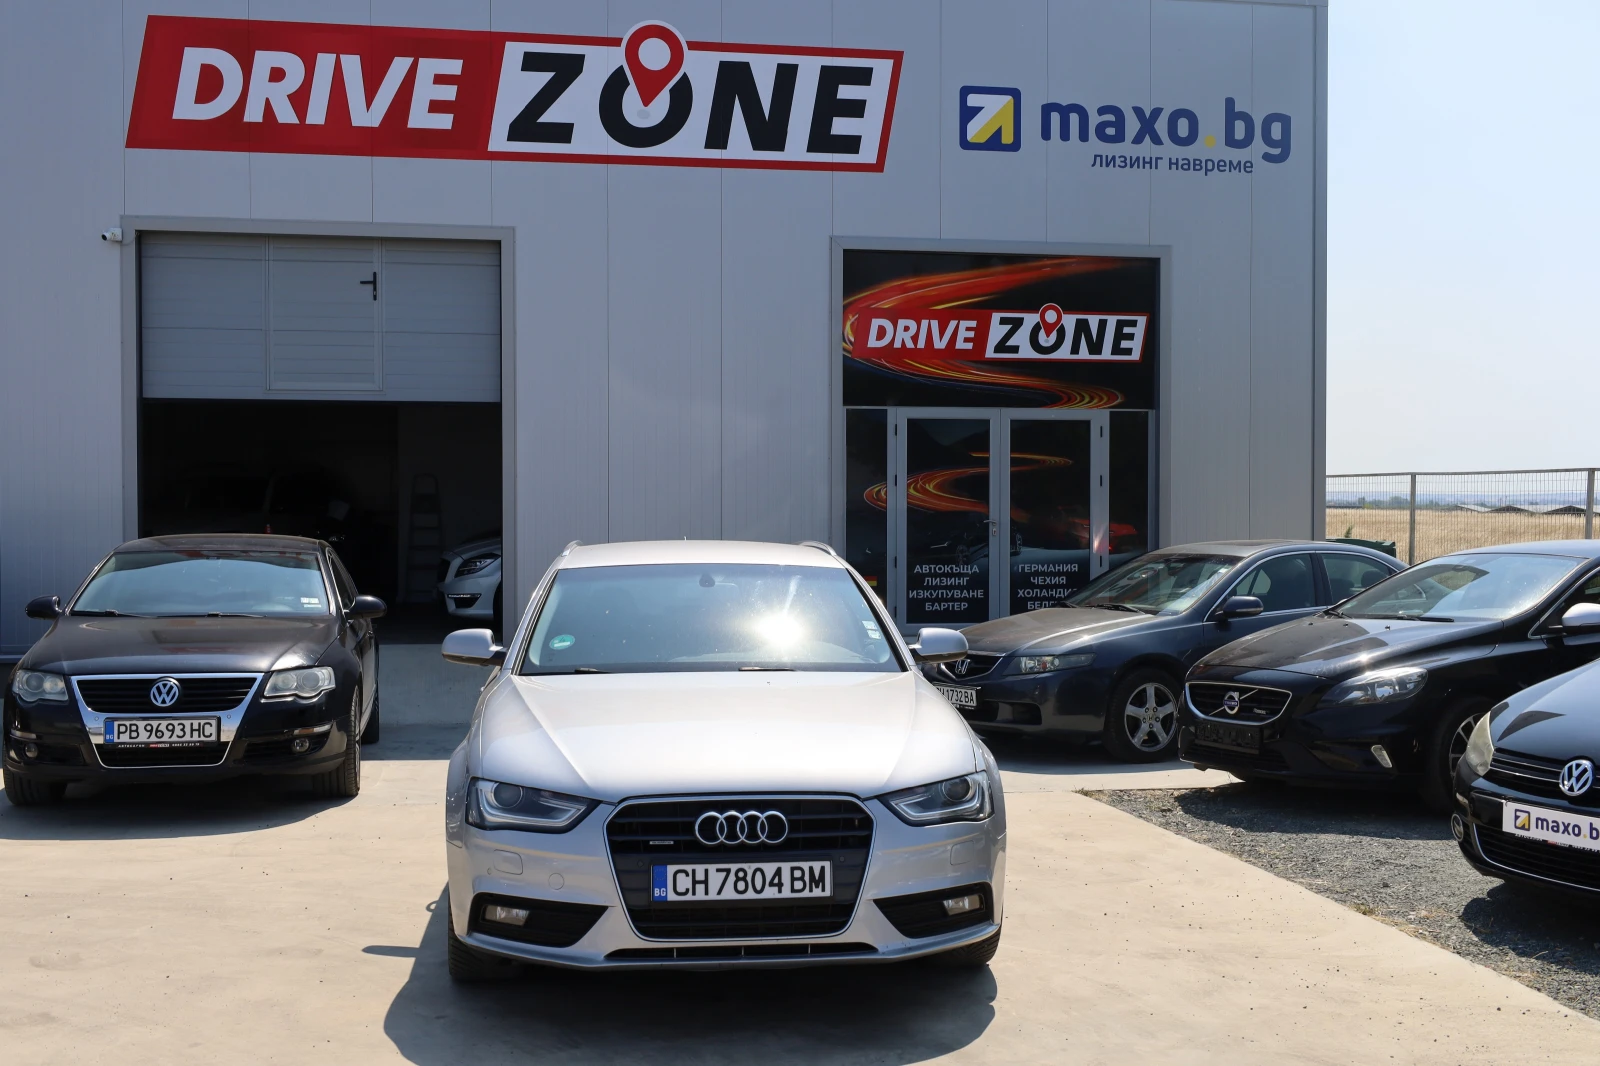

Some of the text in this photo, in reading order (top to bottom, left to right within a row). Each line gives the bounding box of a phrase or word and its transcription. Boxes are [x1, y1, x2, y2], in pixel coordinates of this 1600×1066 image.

[171, 46, 875, 156] DRIVE ZONE
[1040, 97, 1292, 164] maxo.bg
[1091, 153, 1254, 177] лизинг навреме
[867, 316, 1138, 357] DRIVE ZONE
[913, 564, 980, 574] АВТОКЪЩА
[1018, 563, 1079, 573] ГЕРМАНИЯ
[923, 577, 970, 586] ЛИЗИНГ
[1030, 576, 1067, 585] ЧЕХИЯ
[908, 589, 985, 599] ИЗКУПУВАНЕ
[1017, 588, 1078, 599] ХОЛАНДИ
[925, 602, 969, 611] БАРТЕР
[117, 721, 213, 740] PB 9693 HC
[1535, 816, 1600, 841] maxo.b
[672, 865, 826, 897] CH 7804 BM
[654, 888, 667, 897] BG
